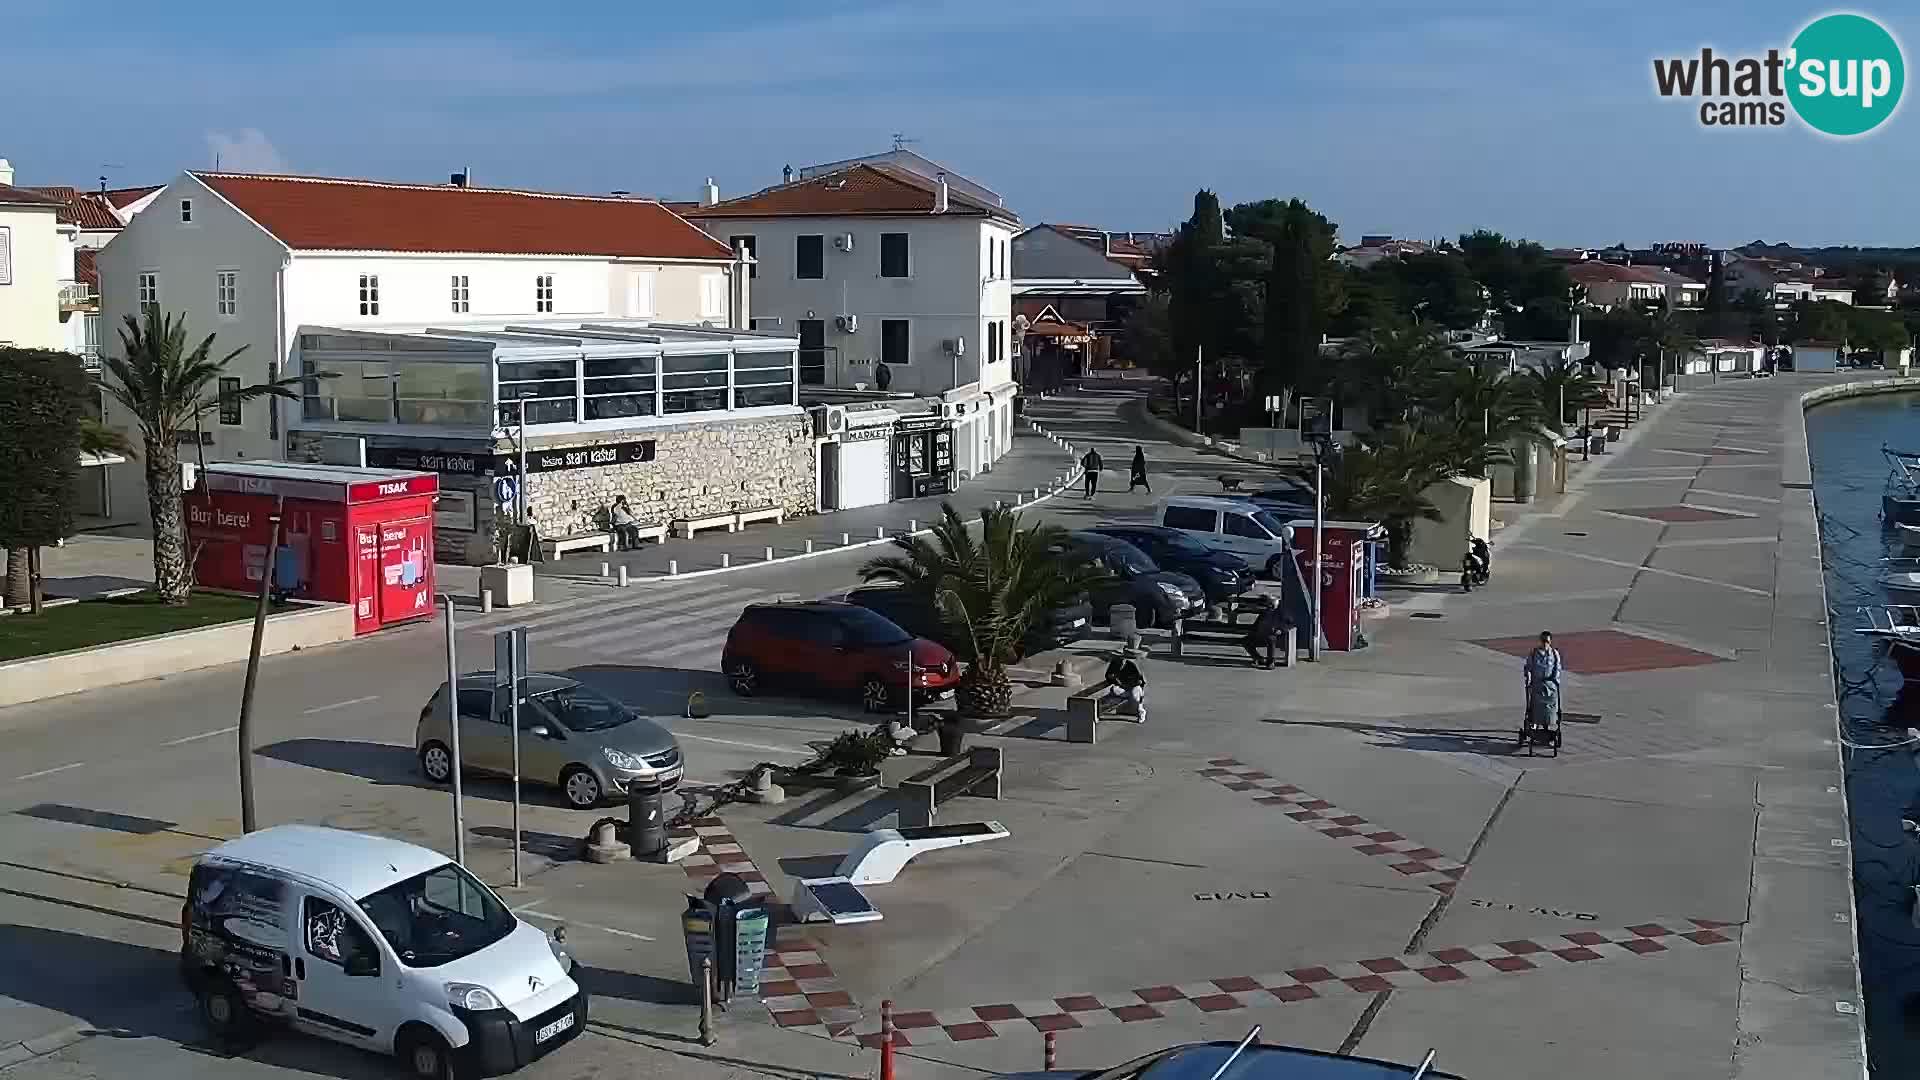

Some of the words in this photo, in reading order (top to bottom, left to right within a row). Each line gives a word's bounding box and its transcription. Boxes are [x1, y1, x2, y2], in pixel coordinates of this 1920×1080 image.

[848, 429, 887, 441] MARKET
[378, 481, 408, 495] TISAK
[359, 533, 378, 545] Buy
